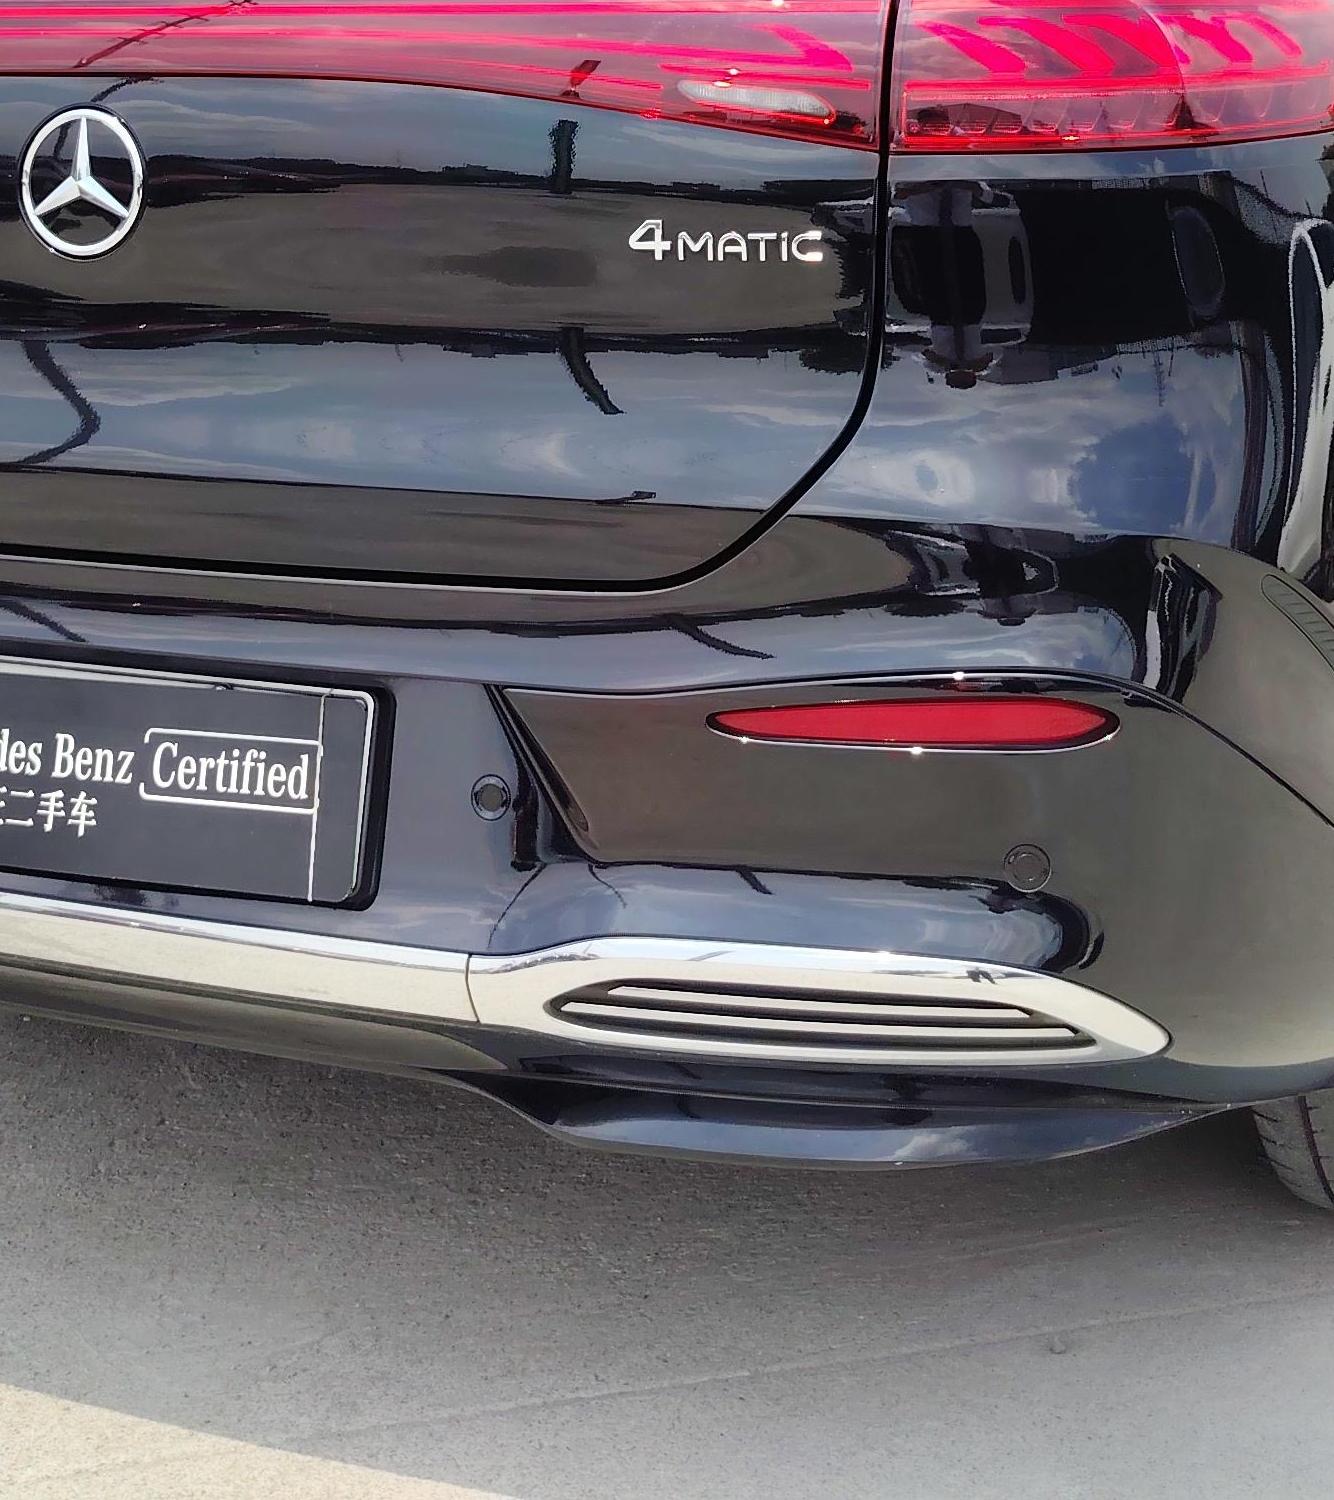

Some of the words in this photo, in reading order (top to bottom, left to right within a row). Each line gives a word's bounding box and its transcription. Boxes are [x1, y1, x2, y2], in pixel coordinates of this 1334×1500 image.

[628, 219, 823, 262] 4MATIC
[51, 732, 135, 785] Benz
[152, 741, 309, 800] Certified
